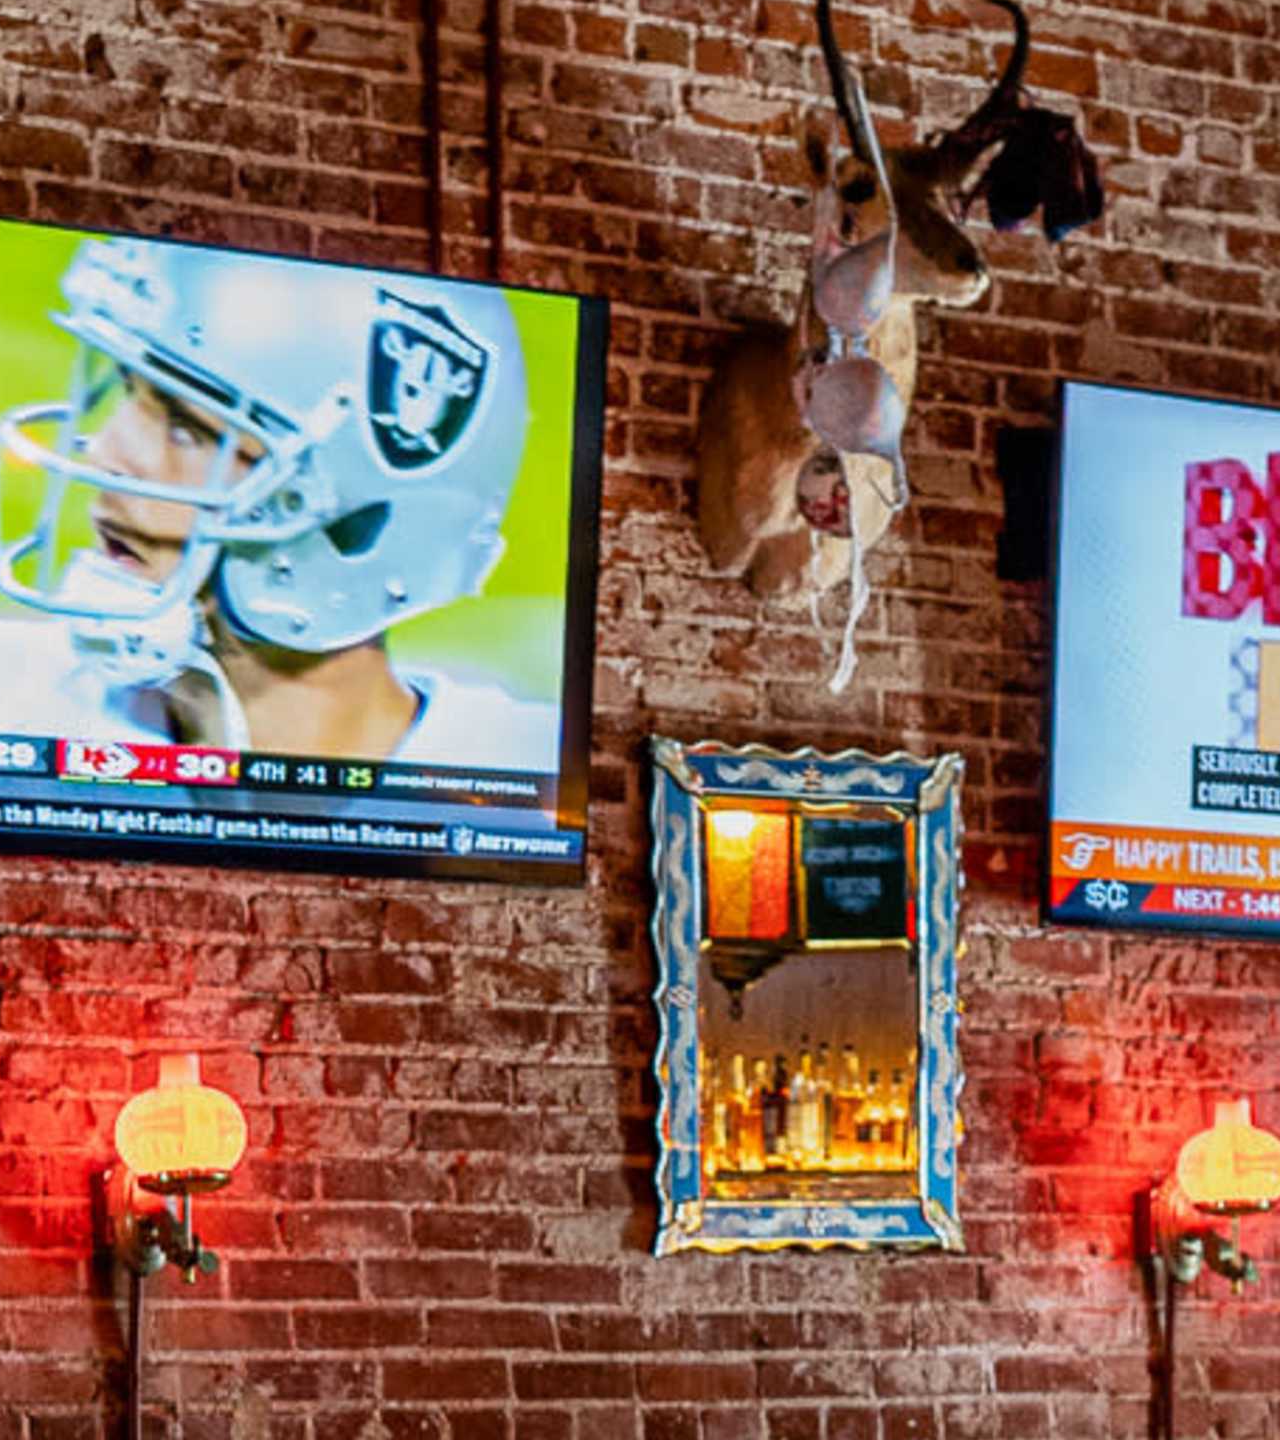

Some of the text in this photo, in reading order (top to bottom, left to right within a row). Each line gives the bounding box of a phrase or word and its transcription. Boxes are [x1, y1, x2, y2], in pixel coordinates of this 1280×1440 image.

[175, 754, 226, 781] 30
[248, 761, 286, 782] 4TH
[347, 767, 372, 787] 25
[5, 805, 32, 823] the
[36, 806, 99, 831] Monday
[100, 810, 145, 833] Night
[148, 813, 213, 835] Football
[216, 821, 258, 839] game
[260, 819, 329, 840] between
[332, 824, 357, 842] the
[360, 824, 417, 847] Raiders
[476, 833, 569, 854] NETWORK
[1113, 838, 1183, 871] HAPPY
[1188, 841, 1265, 880] TRAILS,
[1173, 888, 1225, 910] NEXT
[1241, 893, 1280, 915] 1:44
